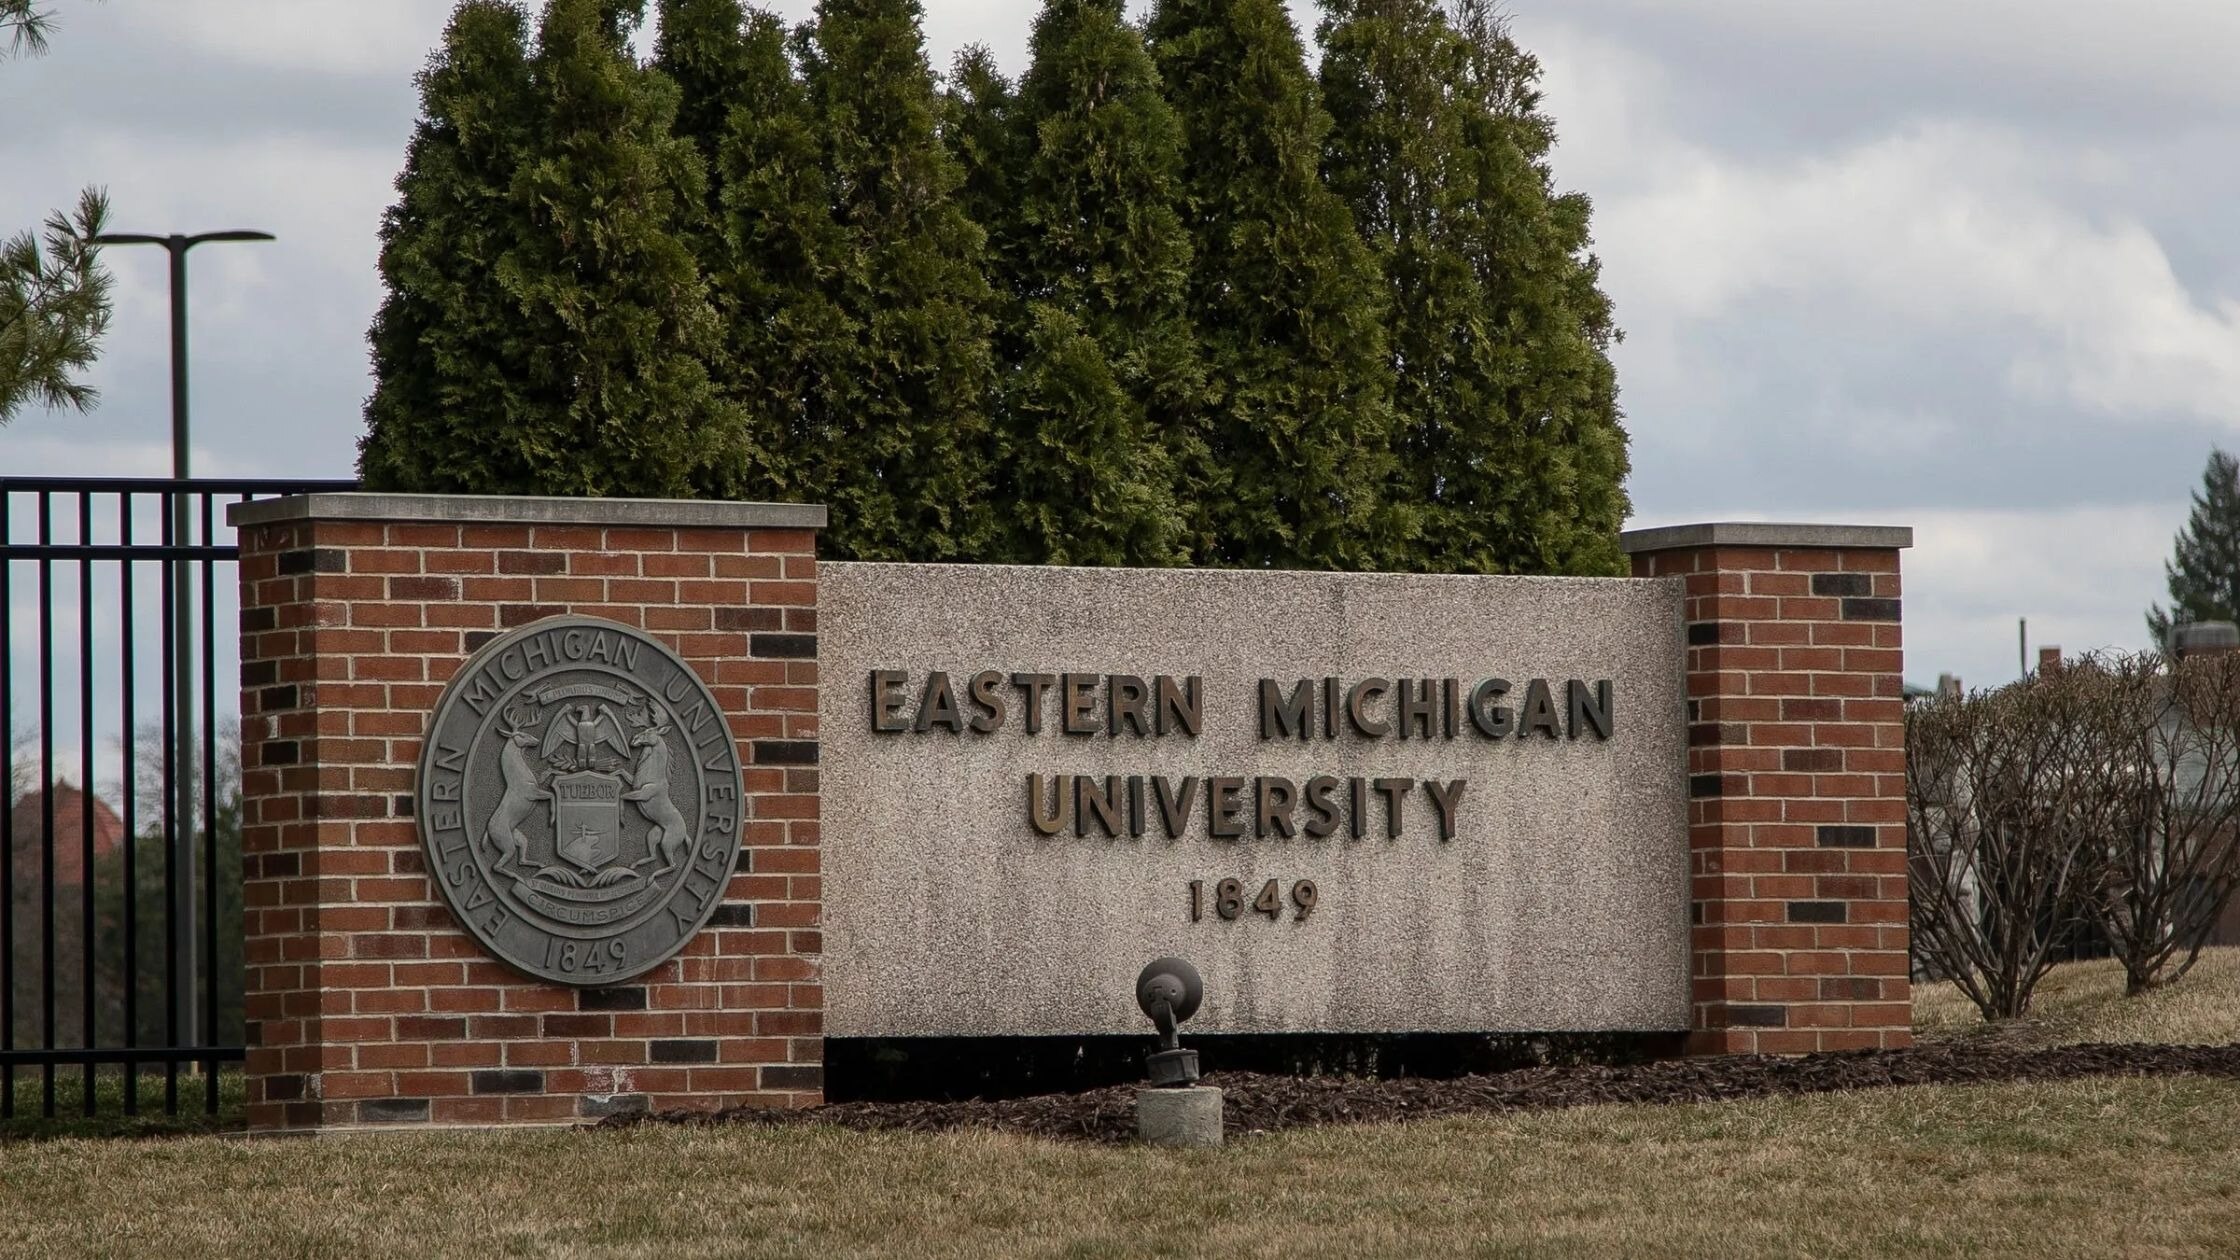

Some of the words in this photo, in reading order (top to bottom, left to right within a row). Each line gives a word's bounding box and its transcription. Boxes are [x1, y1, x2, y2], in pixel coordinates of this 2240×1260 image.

[462, 630, 641, 717] MICHIGAN
[870, 669, 1202, 737] EASTERN
[1259, 676, 1613, 739] MICHIGAN
[665, 669, 735, 936] UNIVERSITY
[1027, 771, 1467, 839] UNIVERSITY
[432, 742, 508, 938] EASTERN
[1189, 877, 1319, 922] 1849
[544, 937, 627, 974] 1849
